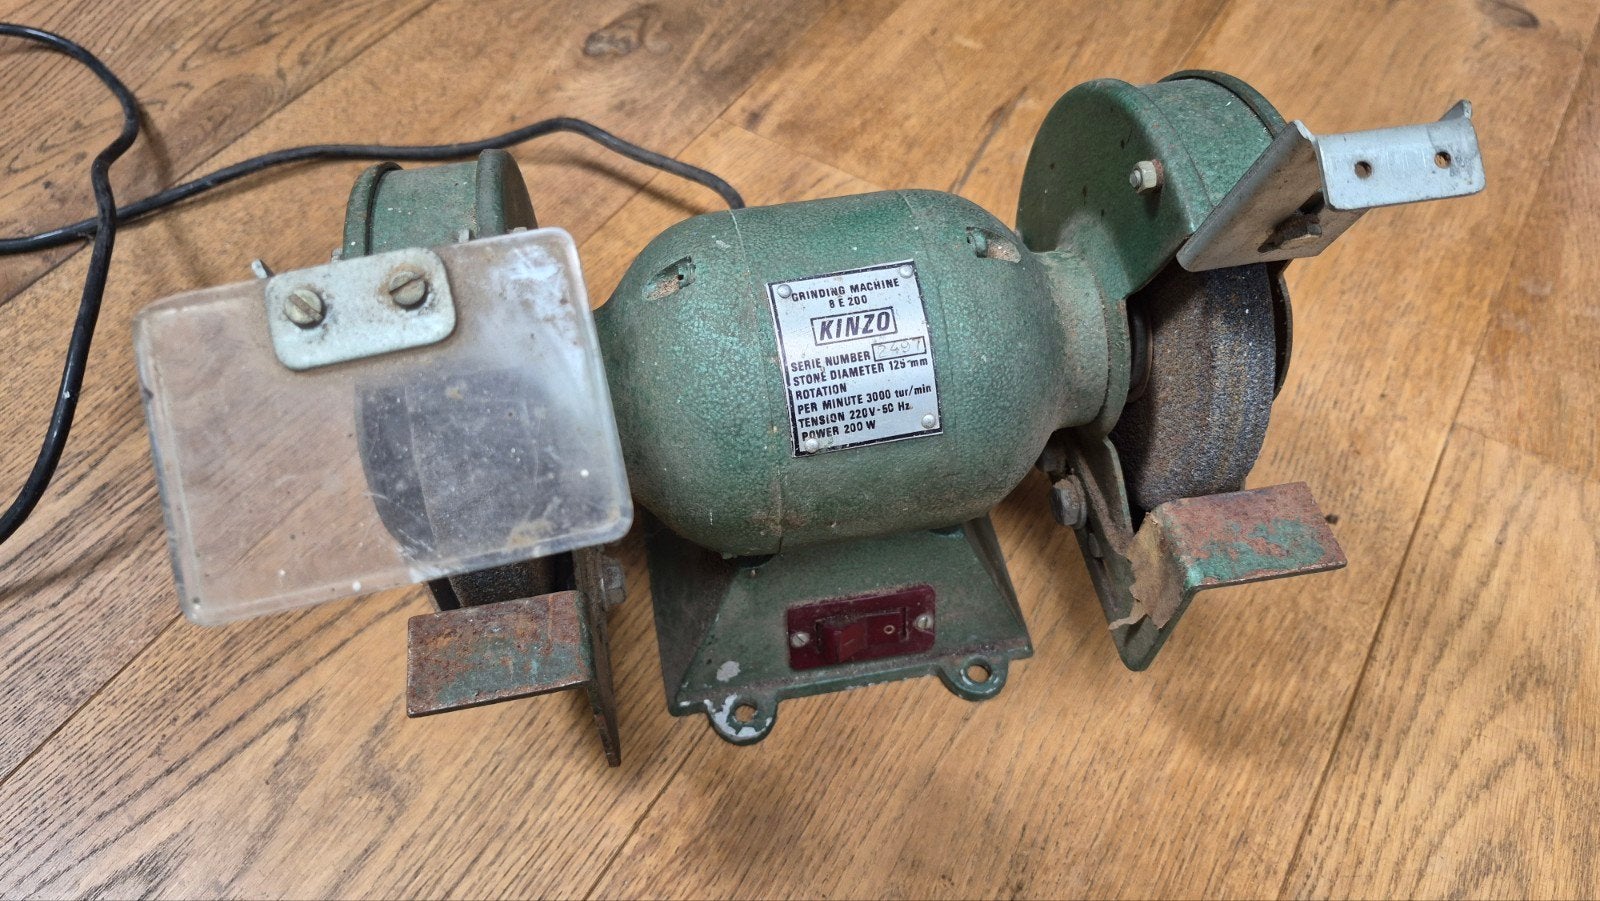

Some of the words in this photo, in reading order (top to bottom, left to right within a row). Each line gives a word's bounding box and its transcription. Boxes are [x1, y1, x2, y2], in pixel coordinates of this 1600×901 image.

[791, 286, 845, 302] GRINDING
[850, 278, 900, 293] MACHINE
[839, 298, 845, 308] E
[849, 295, 868, 306] 200
[819, 311, 890, 342] KINZO
[791, 359, 821, 372] SERIE
[825, 351, 871, 366] NUMBER
[793, 372, 827, 387] STONE
[830, 362, 885, 380] DIAMETER
[910, 358, 928, 368] mm
[796, 383, 847, 400] ROTATION
[798, 402, 818, 415] PER
[823, 394, 863, 411] MINUTE
[866, 389, 891, 403] 3000
[895, 384, 932, 398] tur/min
[800, 412, 845, 429] TENSION
[802, 427, 840, 442] POWER
[844, 423, 863, 434] 200
[866, 419, 876, 430] W
